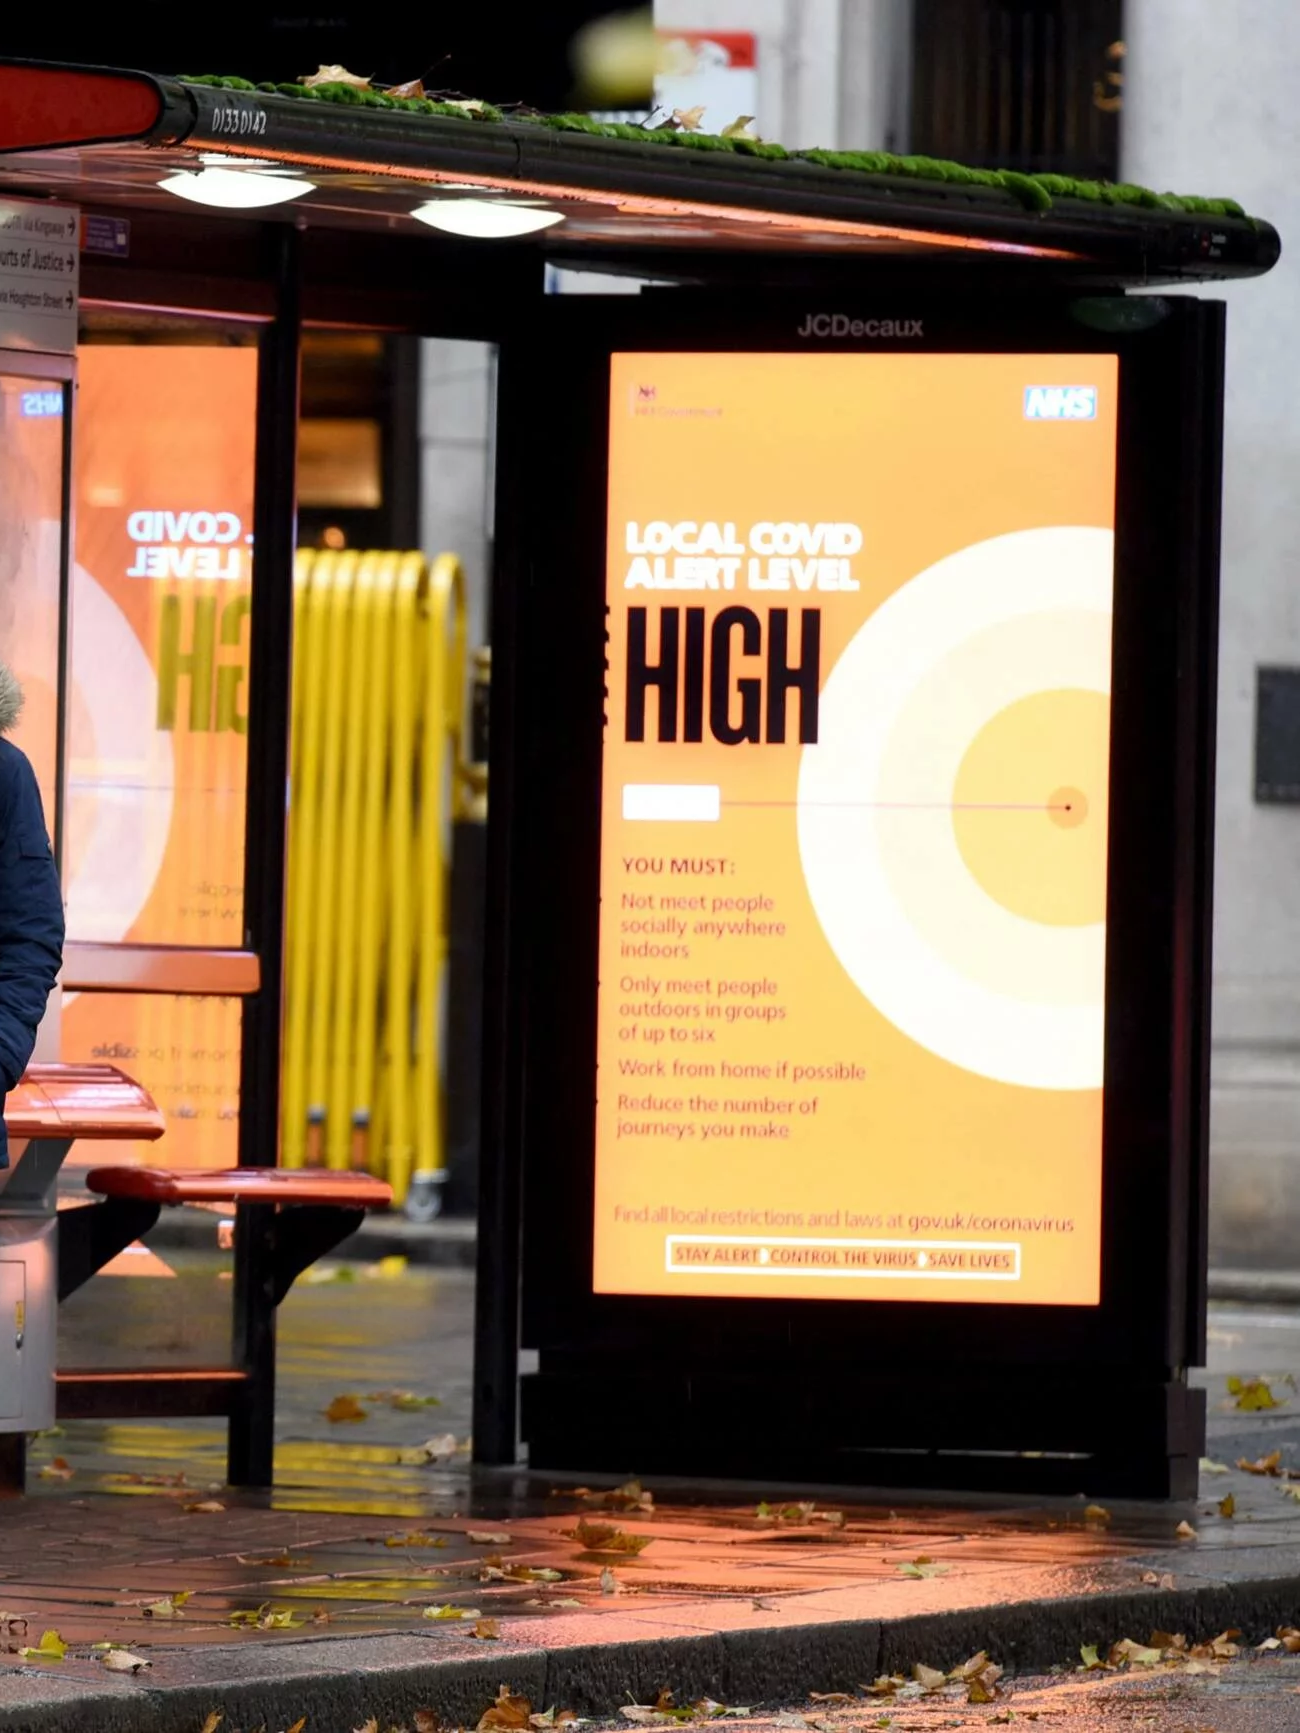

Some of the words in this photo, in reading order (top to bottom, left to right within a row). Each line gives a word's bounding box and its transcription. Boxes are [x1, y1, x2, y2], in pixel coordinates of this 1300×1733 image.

[20, 247, 31, 269] of
[32, 249, 65, 273] Justice
[797, 313, 923, 337] JCDecaux
[1026, 387, 1094, 418] NHS
[625, 522, 745, 554] LOCAL
[748, 522, 863, 556] COVID
[624, 557, 742, 590] ALERT
[748, 558, 860, 591] LEVEL
[624, 605, 821, 746] HIGH
[622, 858, 663, 875] YOU
[670, 858, 736, 876] MUST:
[621, 894, 654, 910] Not
[661, 896, 705, 911] meet
[712, 895, 774, 914] people
[621, 918, 686, 938] socially
[694, 919, 786, 938] anywhere
[621, 941, 689, 959] indoors
[620, 976, 660, 996] Only
[666, 979, 711, 995] meet
[718, 978, 777, 998] people
[619, 1002, 700, 1018] outdoors
[706, 1003, 720, 1018] in
[725, 1006, 786, 1023] groups
[619, 1026, 637, 1042] of
[643, 1029, 664, 1045] up
[670, 1028, 688, 1042] to
[692, 1027, 716, 1042] six
[619, 1060, 666, 1077] Work
[673, 1060, 715, 1078] from
[720, 1061, 771, 1079] home
[776, 1062, 787, 1079] if
[793, 1062, 866, 1083] possible
[618, 1095, 683, 1112] Reduce
[689, 1096, 719, 1113] the
[724, 1097, 795, 1115] number
[799, 1097, 819, 1115] of
[617, 1119, 695, 1140] journeys
[701, 1122, 735, 1139] you
[740, 1121, 790, 1138] make
[614, 1206, 648, 1222] Find
[654, 1207, 669, 1222] all
[671, 1208, 708, 1224] local
[711, 1208, 804, 1226] restrictions
[808, 1211, 840, 1227] and
[845, 1211, 882, 1228] laws
[889, 1212, 903, 1228] at
[908, 1213, 1075, 1232] gov.uk/coronavirus
[676, 1247, 710, 1261] STAY
[714, 1248, 758, 1262] ALERT
[770, 1249, 838, 1264] CONTROL
[843, 1250, 869, 1265] THE
[873, 1251, 916, 1266] VIRUS
[930, 1253, 965, 1267] SAVE
[970, 1254, 1010, 1268] LIVES
